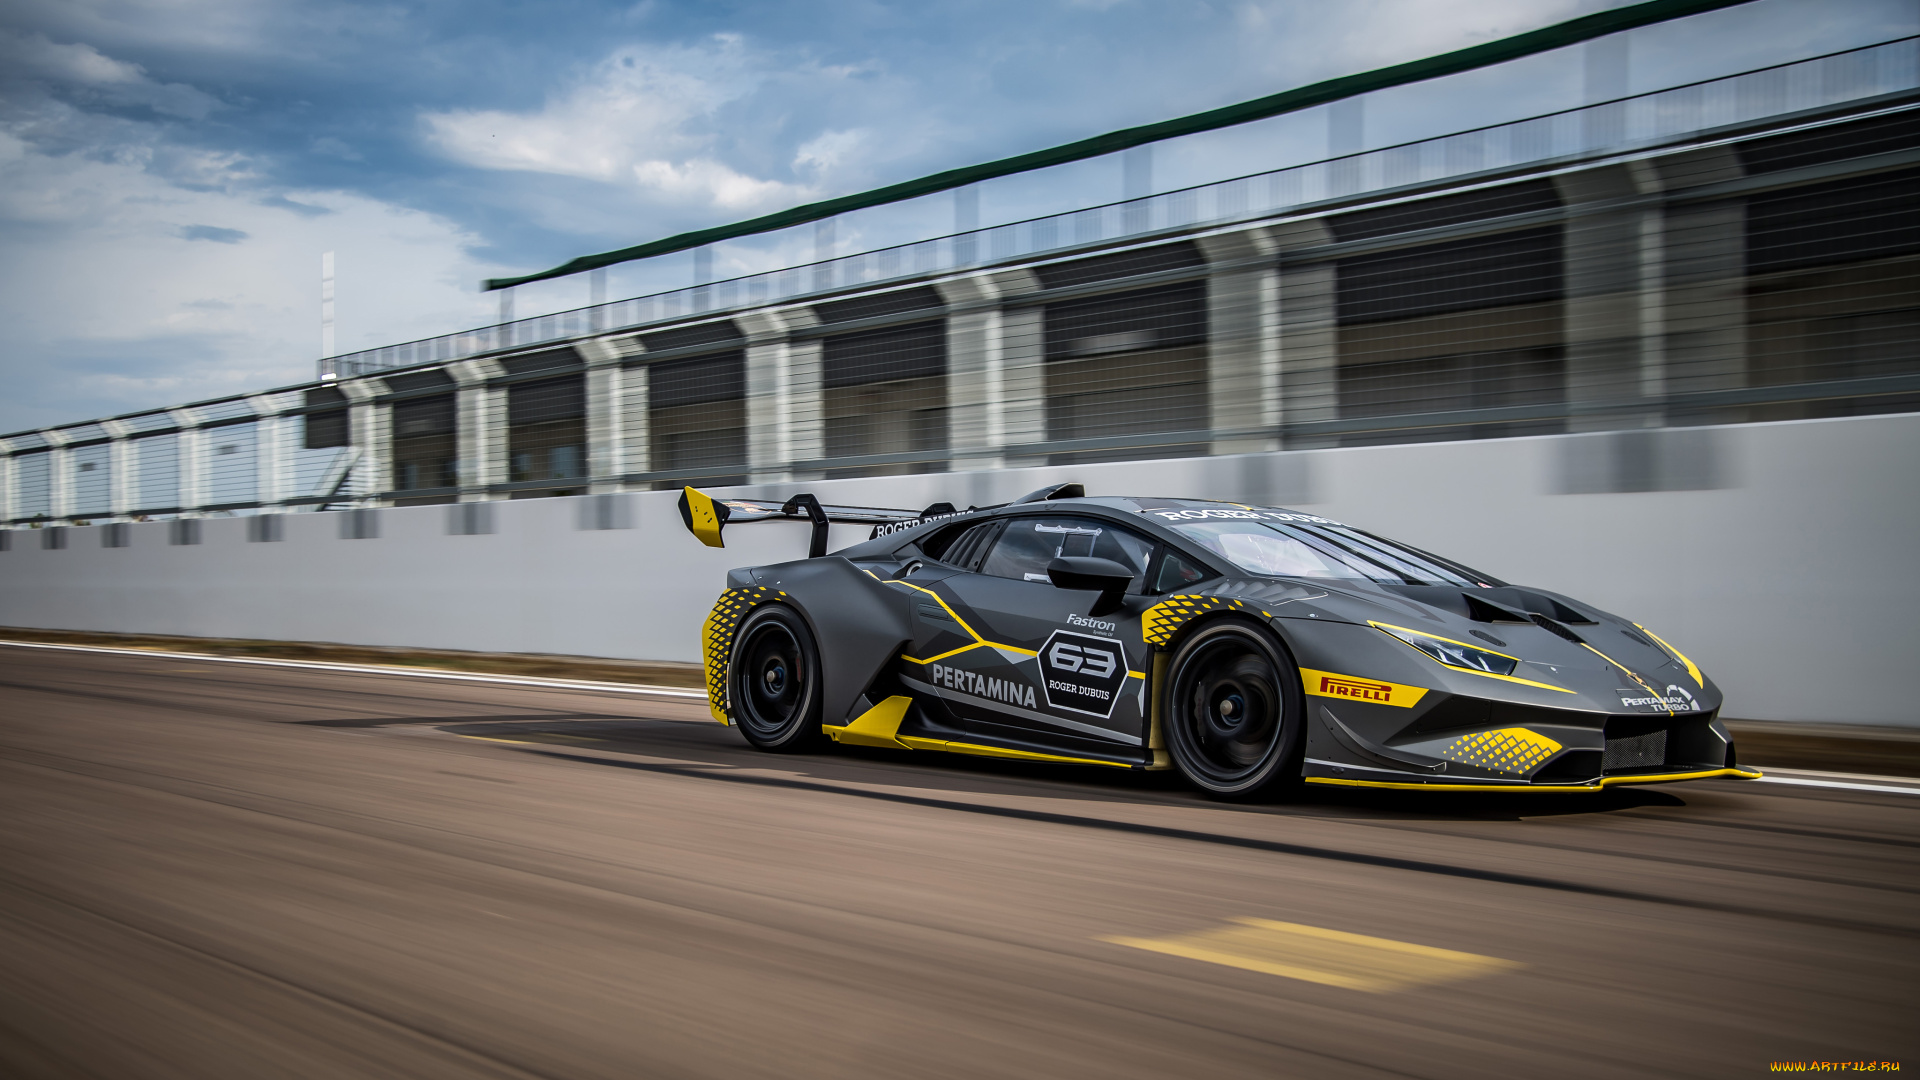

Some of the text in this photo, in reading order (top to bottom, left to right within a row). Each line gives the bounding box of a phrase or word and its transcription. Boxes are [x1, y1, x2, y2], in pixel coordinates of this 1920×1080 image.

[1154, 509, 1270, 521] ROGER
[1066, 613, 1116, 632] Fastron
[1049, 641, 1117, 679] 63
[933, 663, 1037, 709] PERTAMINA
[1049, 679, 1110, 701] ROGER DUBUIS
[1320, 676, 1392, 702] PIRELLI
[1651, 703, 1690, 712] TURBO
